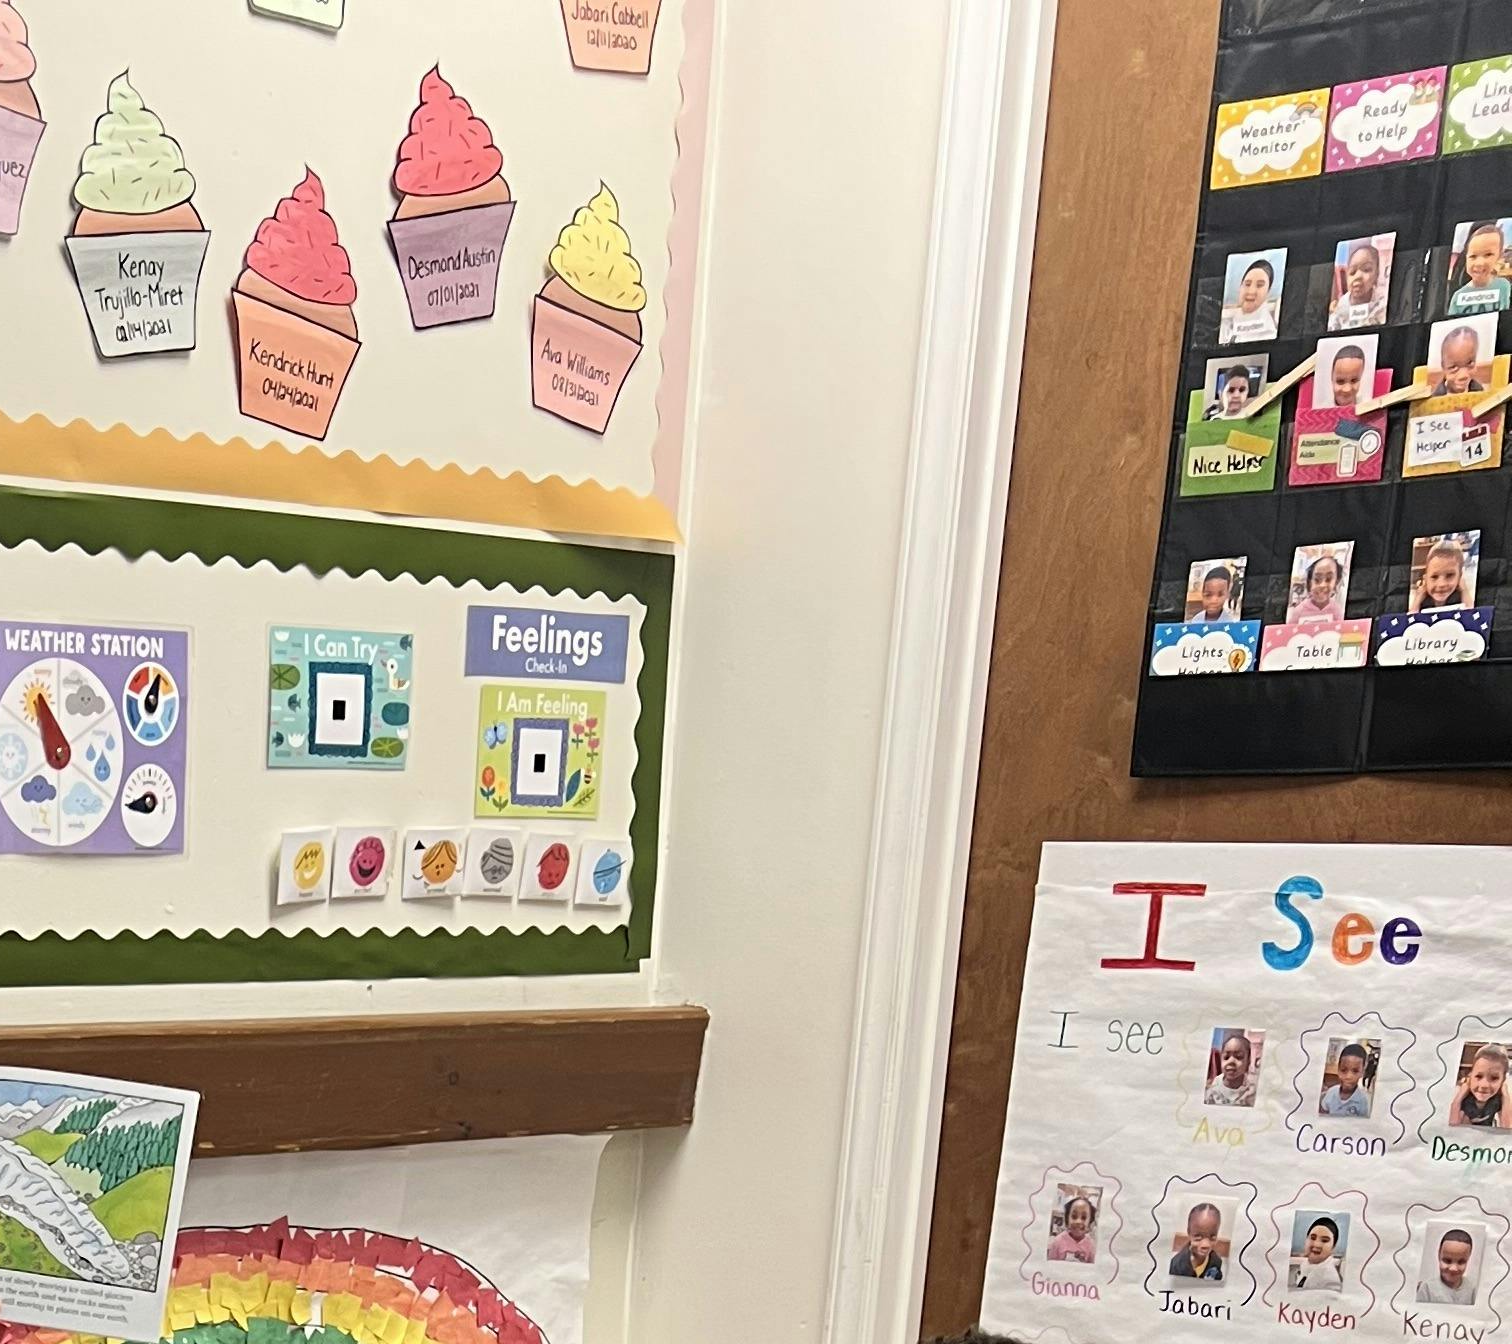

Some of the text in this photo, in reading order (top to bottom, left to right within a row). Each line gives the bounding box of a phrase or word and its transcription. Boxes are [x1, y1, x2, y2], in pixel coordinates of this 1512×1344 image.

[1363, 100, 1407, 119] Ready
[1240, 121, 1301, 140] Weather
[1357, 123, 1408, 143] to Help
[1240, 140, 1297, 157] Monitor
[118, 252, 166, 284] Kenay
[407, 246, 496, 281] Desmond Austin
[248, 338, 335, 389] Kendrick Hunt
[541, 337, 611, 387] Ava Williams
[1464, 442, 1484, 459] 14
[4, 628, 164, 659] WEATHER STATION
[303, 631, 379, 666] I Can Try
[492, 614, 604, 667] Feelings
[1181, 645, 1224, 663] Lights
[1295, 644, 1334, 659] Table
[1404, 637, 1459, 653] Library
[524, 656, 568, 675] Check-In
[497, 690, 589, 721] I Am Feeling
[1099, 874, 1423, 972] I See
[1047, 1010, 1165, 1055] I see
[1192, 1116, 1246, 1148] Ava
[1295, 1123, 1387, 1158] Carson
[1031, 1270, 1102, 1302] Gianna
[1157, 1289, 1233, 1322] Jabari
[1276, 1301, 1357, 1335] Kayden
